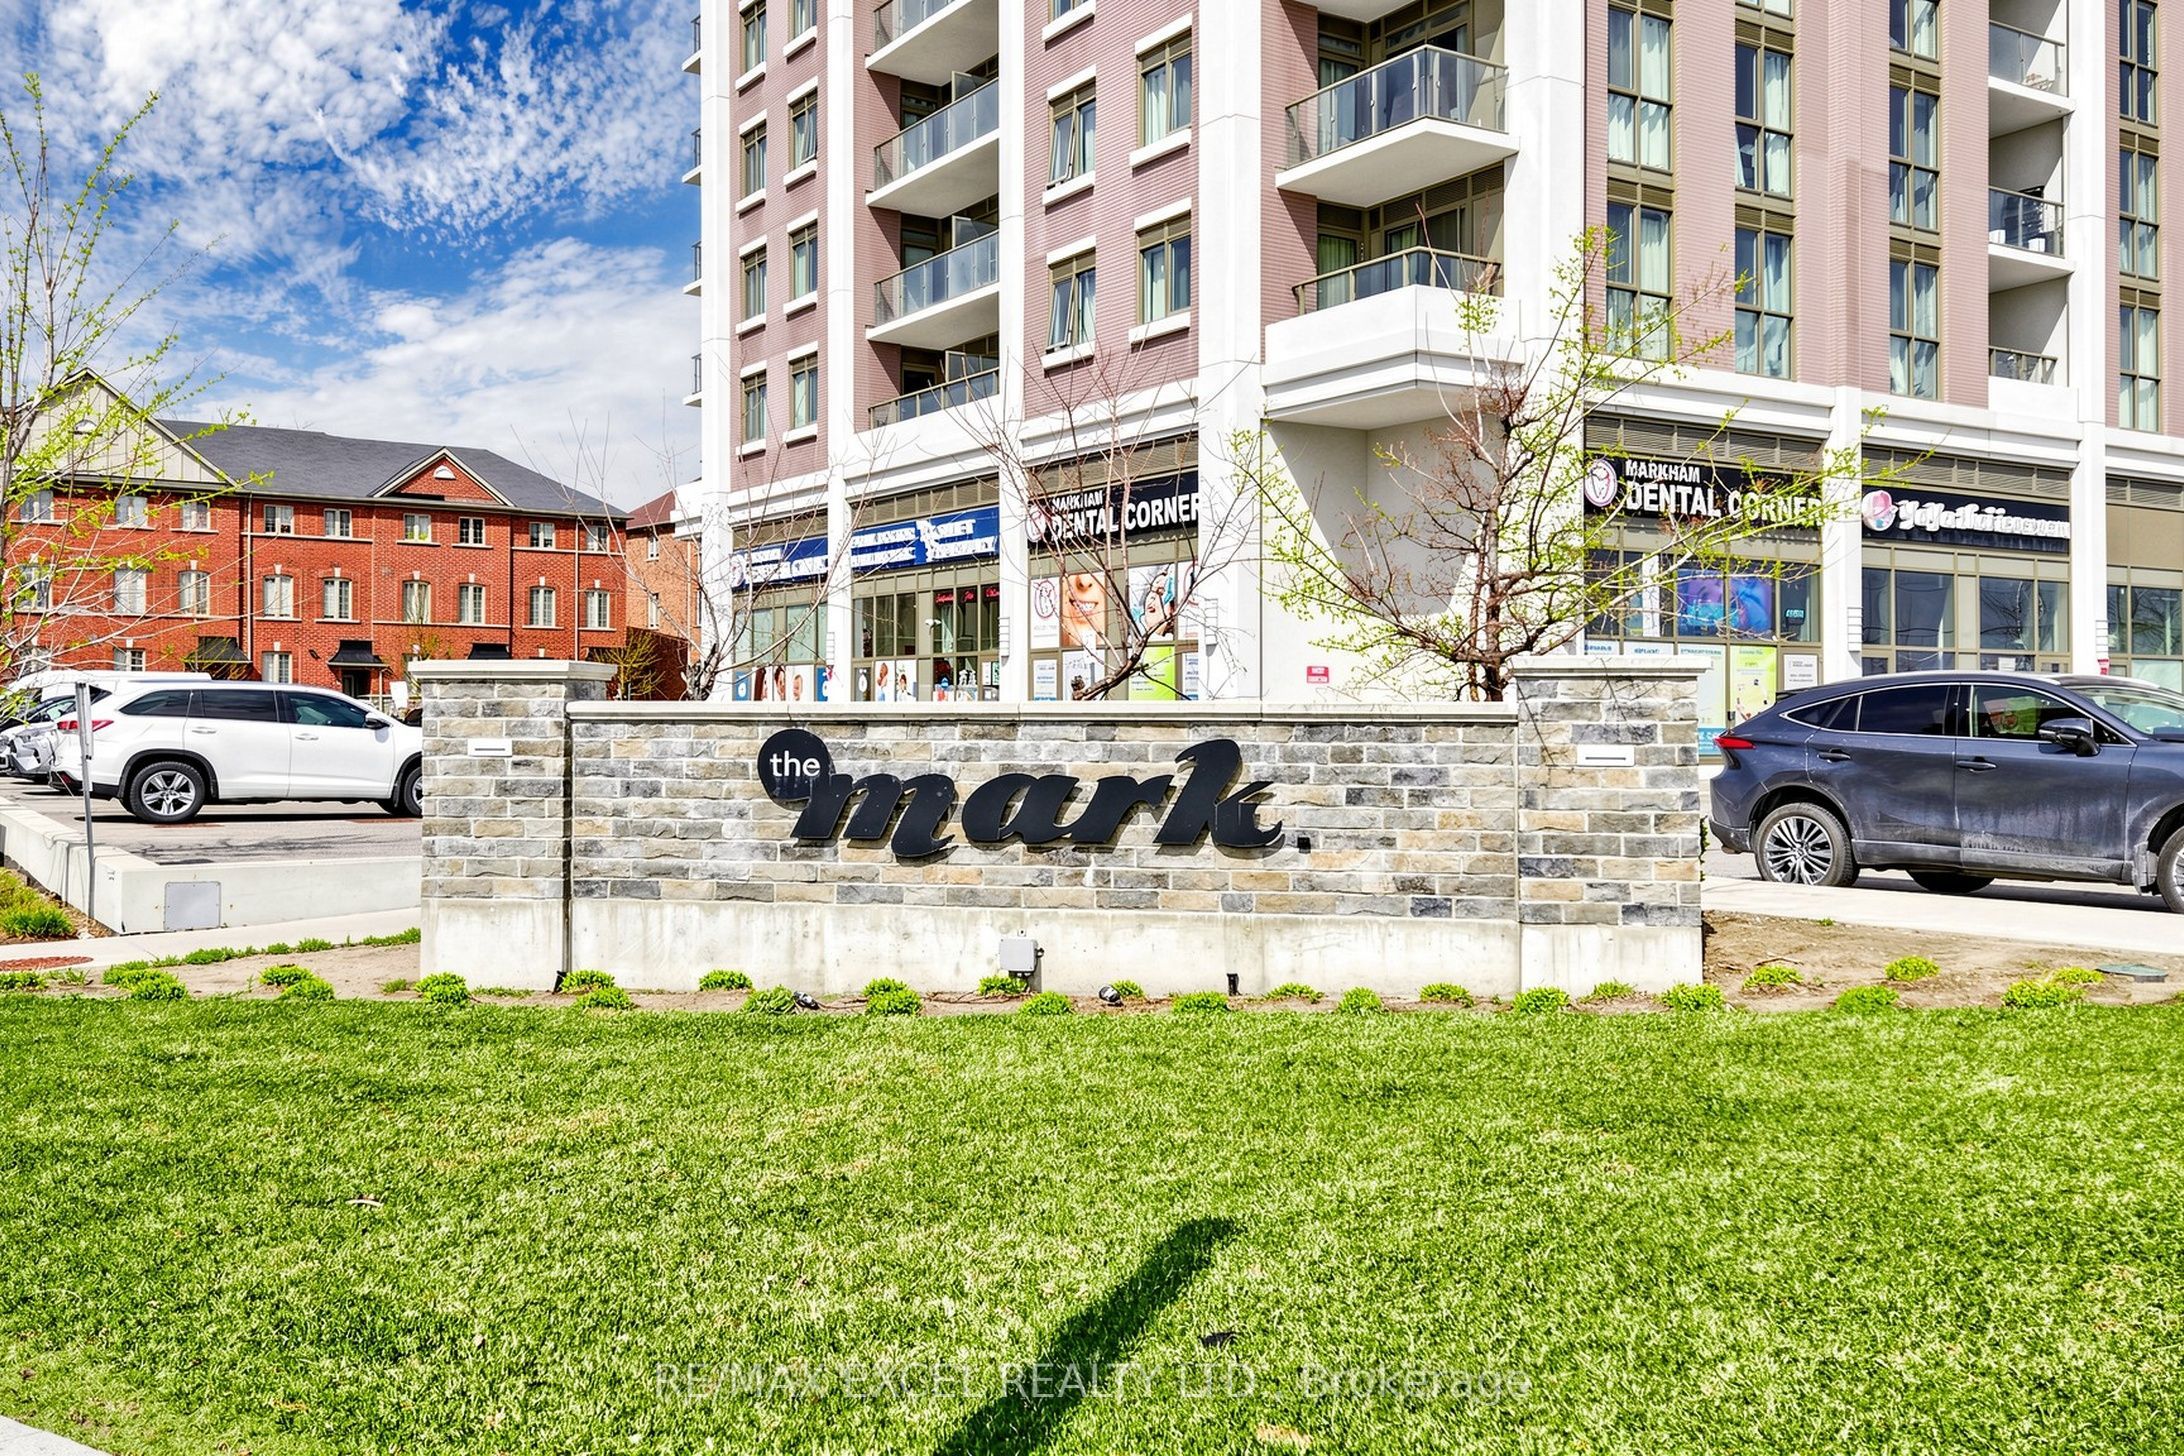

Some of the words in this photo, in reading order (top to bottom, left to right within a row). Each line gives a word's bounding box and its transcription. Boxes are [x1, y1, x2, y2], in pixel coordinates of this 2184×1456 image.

[1625, 459, 1701, 483] MARKHAM
[1626, 480, 1721, 519] DENTAL
[1050, 507, 1119, 541] DENTAL
[769, 750, 821, 778] the
[790, 739, 1282, 858] mark
